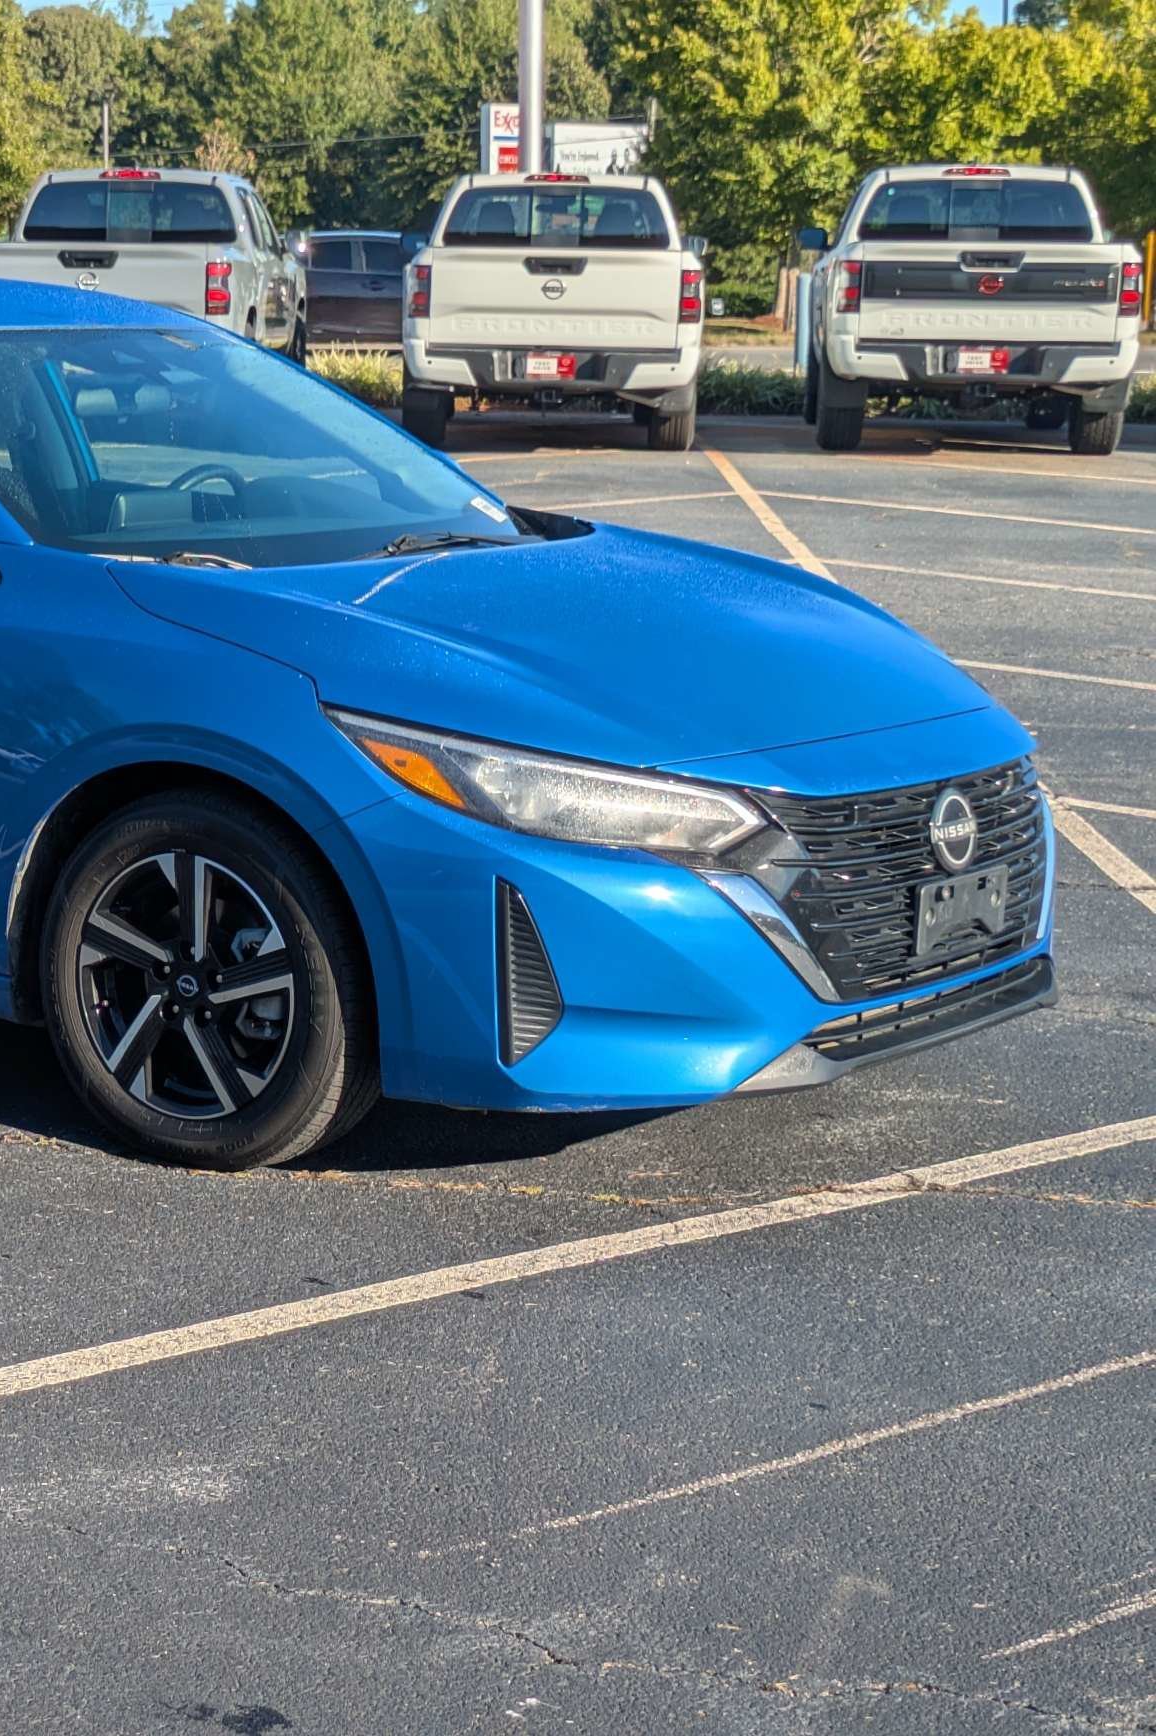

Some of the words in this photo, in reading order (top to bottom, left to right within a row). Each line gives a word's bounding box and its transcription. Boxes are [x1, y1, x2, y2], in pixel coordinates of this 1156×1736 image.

[452, 317, 657, 336] FRONTIER
[882, 311, 1093, 330] FRONTIER
[934, 821, 975, 841] NISSAN
